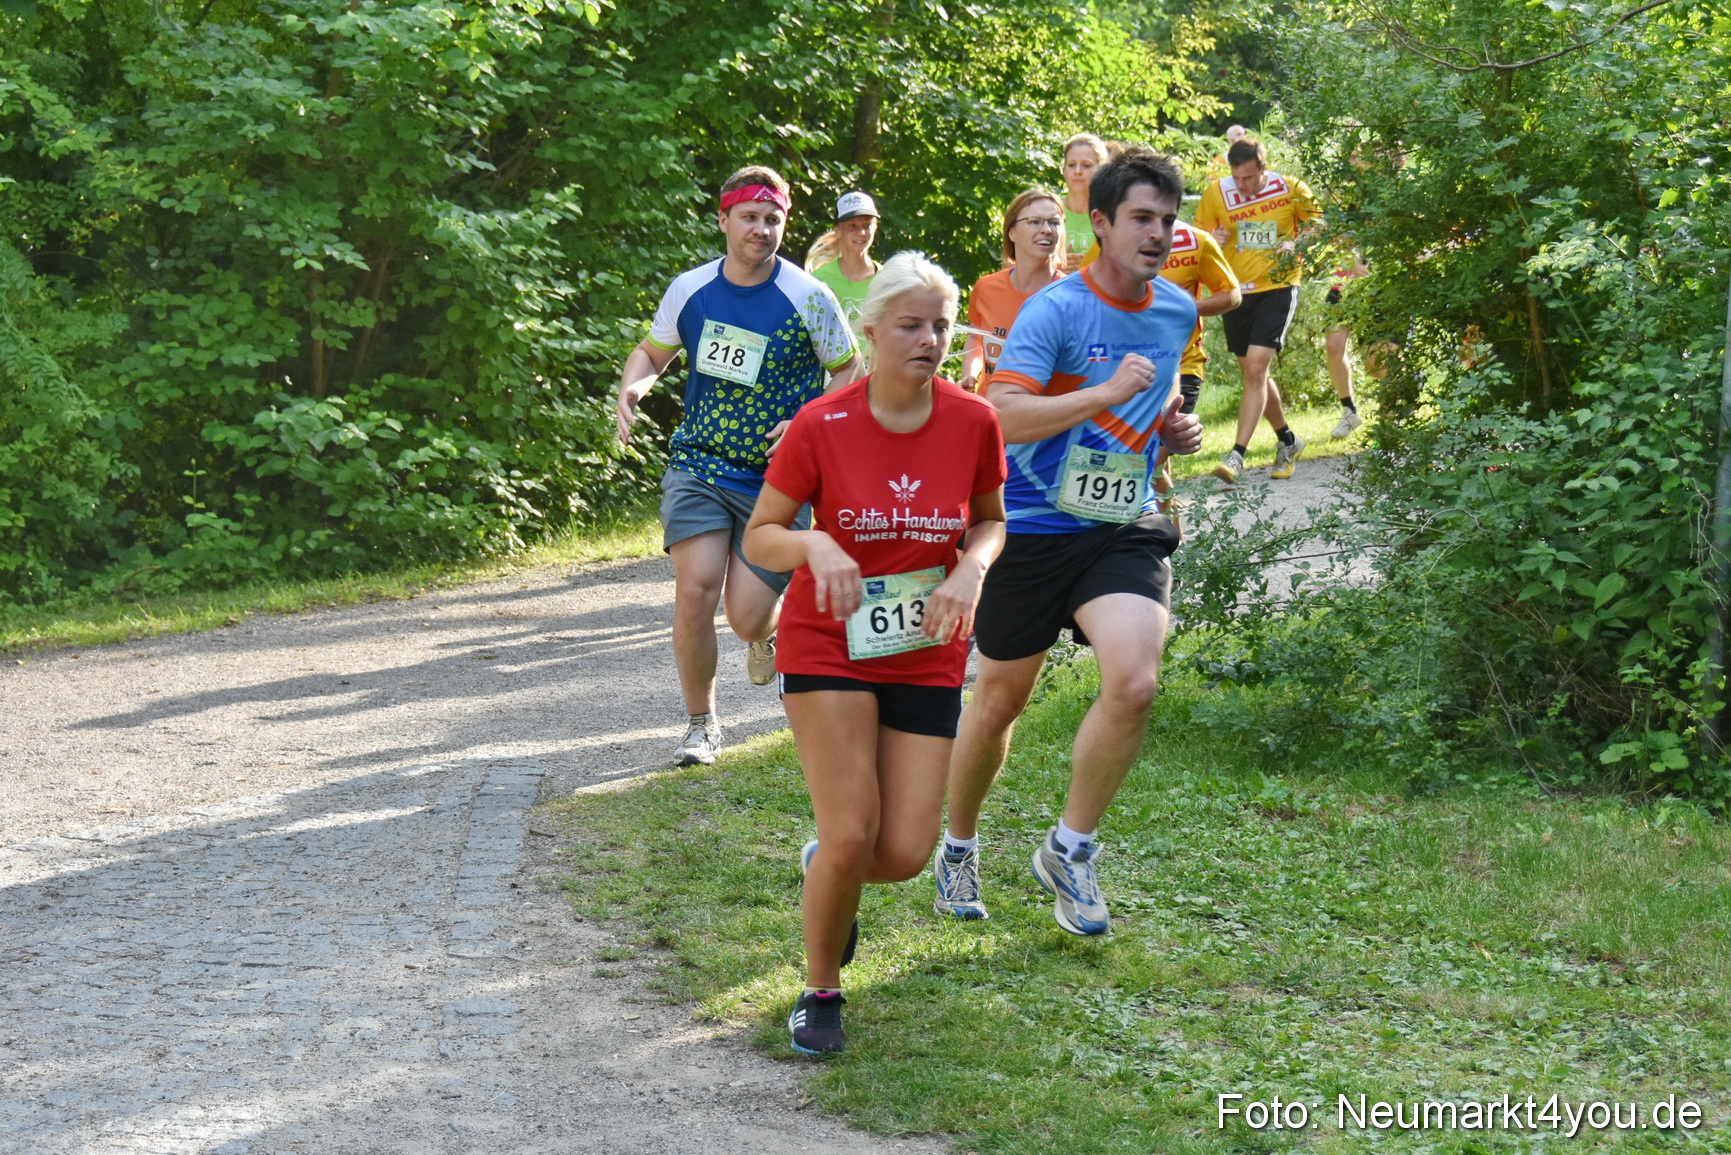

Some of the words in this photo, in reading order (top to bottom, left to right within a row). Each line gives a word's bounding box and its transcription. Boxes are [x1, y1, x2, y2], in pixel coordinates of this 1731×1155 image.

[1229, 208, 1257, 224] MAX
[1260, 198, 1292, 213] BÖGL
[707, 341, 746, 367] 218
[729, 365, 748, 376] Markus
[1076, 474, 1136, 504] 1913
[1077, 498, 1097, 507] Franz
[1098, 502, 1129, 511] Christoph
[837, 508, 890, 530] Echtes
[854, 532, 897, 543] IMMER
[902, 531, 950, 543] FRISCH
[870, 600, 924, 634] 613
